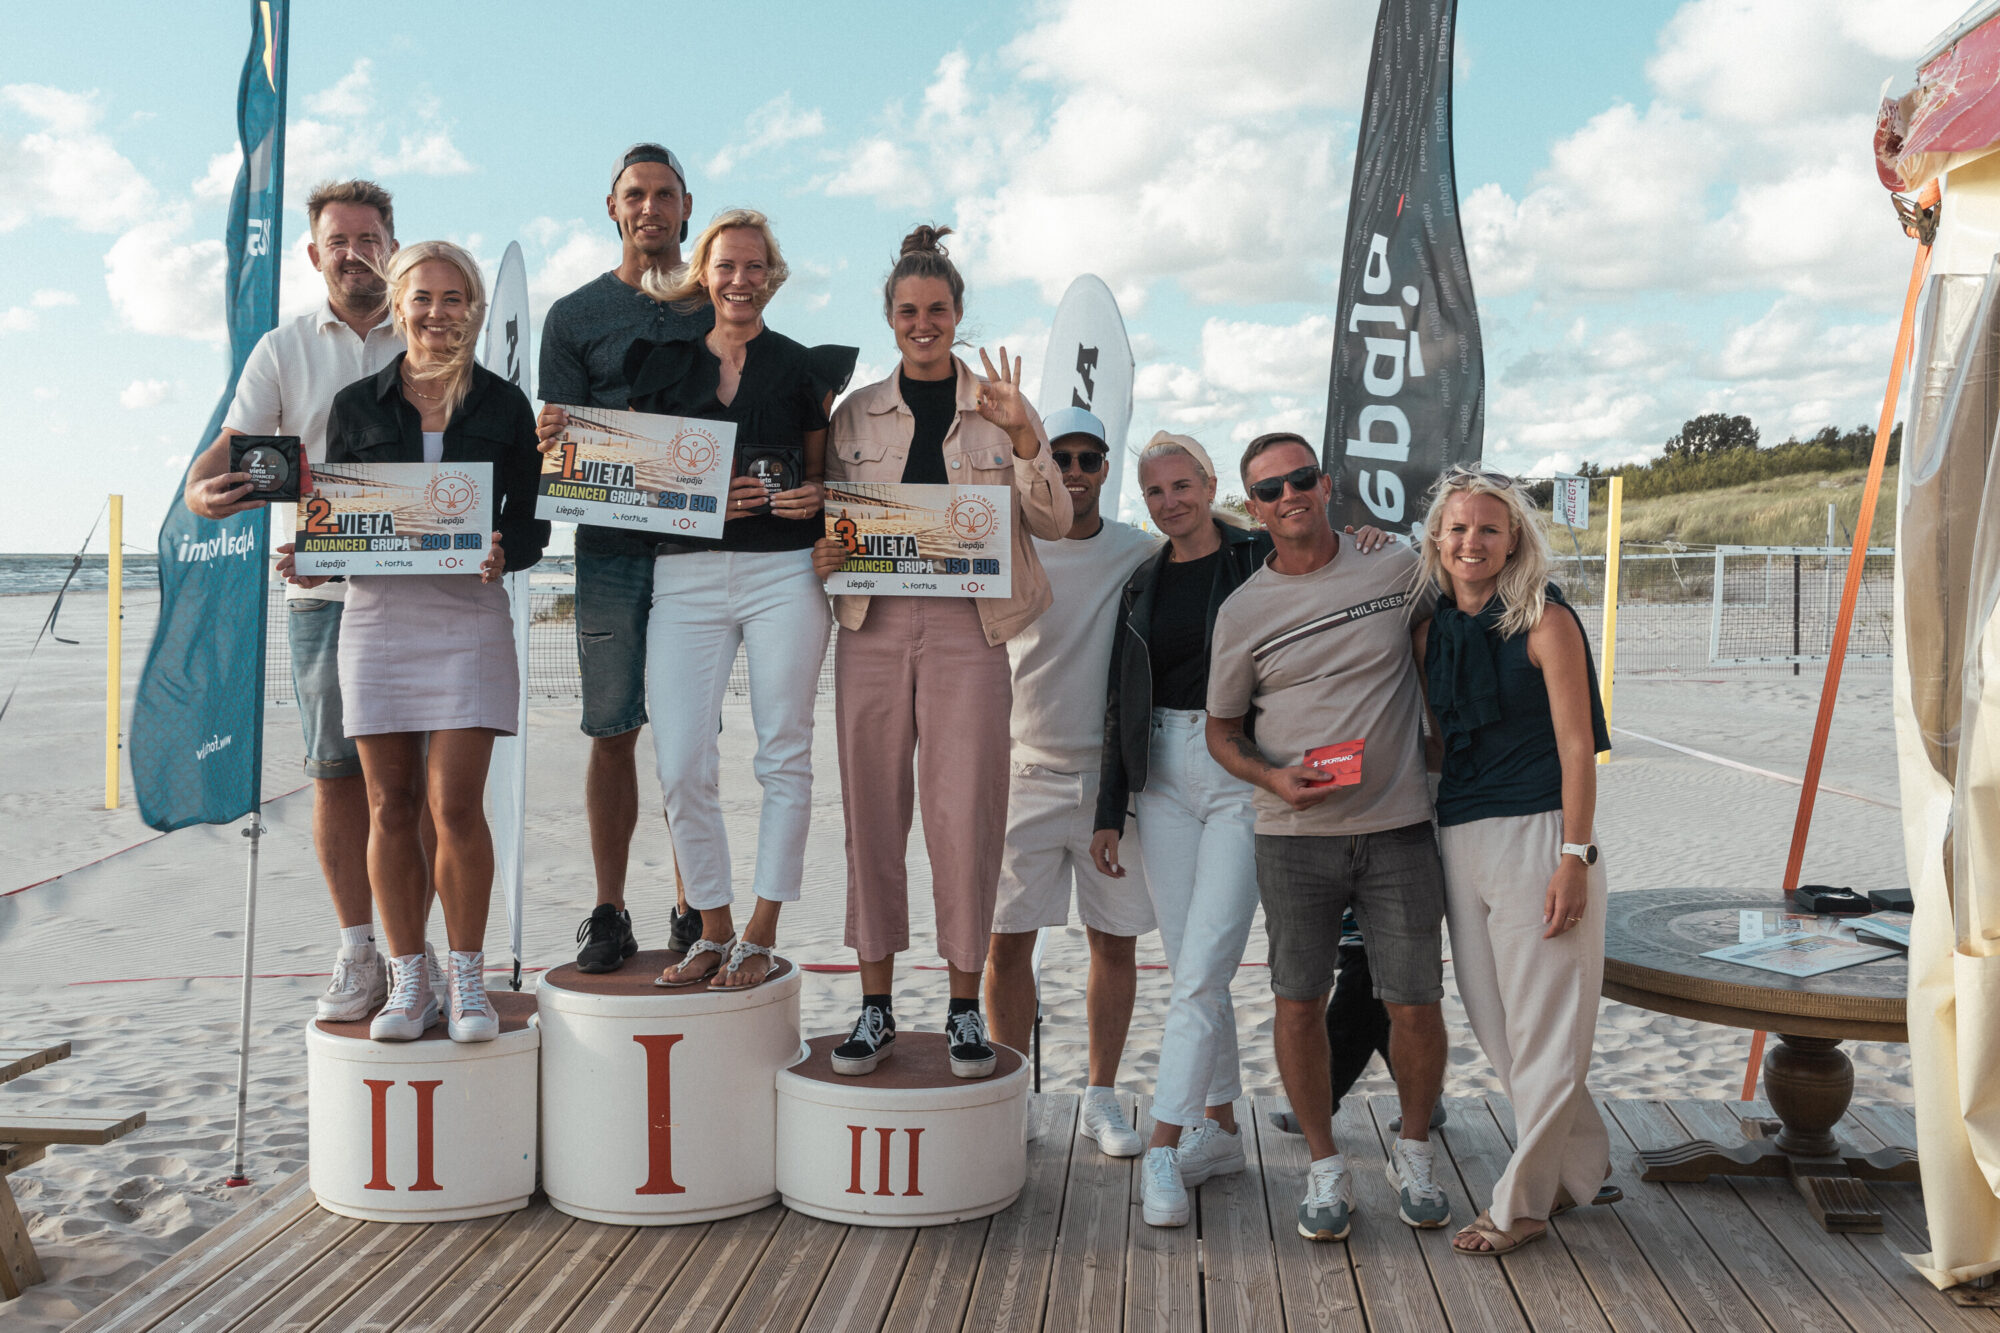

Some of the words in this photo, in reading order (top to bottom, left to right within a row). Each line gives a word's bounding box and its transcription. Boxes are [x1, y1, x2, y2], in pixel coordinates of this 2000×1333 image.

[251, 450, 265, 468] 2.
[581, 461, 635, 487] VIETA
[676, 475, 703, 485] Liepāja
[548, 484, 607, 501] ADVANCED
[610, 489, 648, 506] GRUPĀ
[658, 491, 687, 510] 250
[689, 495, 717, 513] EUR
[1567, 478, 1577, 525] AIZLIEGTS
[556, 504, 586, 516] Liepāja
[620, 512, 648, 524] fortius
[337, 513, 395, 535] VIETA
[437, 516, 465, 526] Liepāja
[305, 538, 367, 552] ADVANCED
[371, 536, 410, 551] GRUPĀ
[421, 534, 451, 550] 200
[454, 533, 482, 550] EUR
[864, 535, 919, 557] VIETA
[958, 541, 984, 550] Liepāja
[315, 558, 347, 568] Liepāja
[897, 559, 934, 574] GRUPĀ
[944, 558, 970, 574] 150
[973, 558, 999, 575] EUR
[847, 580, 875, 589] Liepāja
[910, 582, 937, 590] fortius
[1349, 594, 1404, 619] HILFIGER
[632, 1033, 687, 1195] I
[363, 1079, 444, 1192] II
[846, 1125, 926, 1197] III
